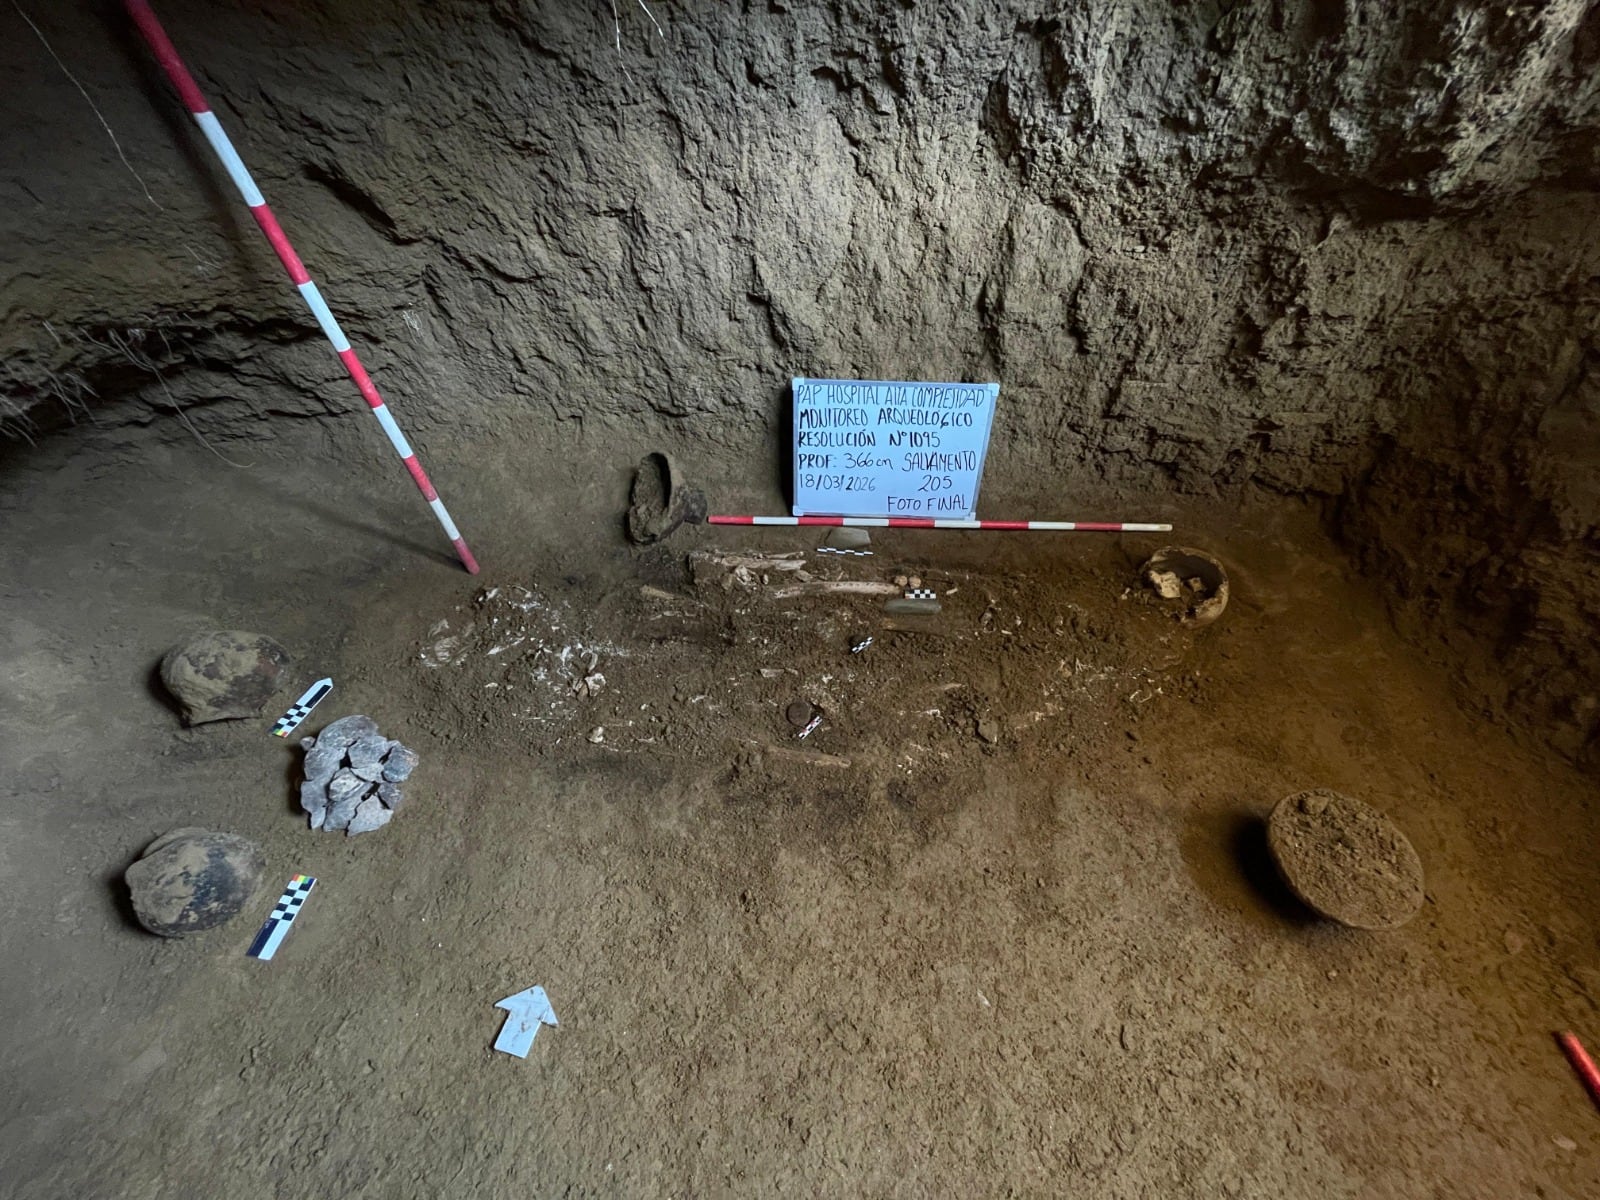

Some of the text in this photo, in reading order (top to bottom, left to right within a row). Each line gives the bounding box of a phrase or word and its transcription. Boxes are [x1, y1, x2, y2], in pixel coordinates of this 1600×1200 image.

[798, 385, 822, 404] PAP
[827, 385, 880, 405] HOSPITAL
[799, 408, 973, 429] MONITOREO ARQUEOLÓGICO
[798, 429, 876, 448] RESOLUCIÓN
[799, 454, 836, 470] PROF:
[902, 451, 976, 472] SALVAMENTO
[799, 474, 953, 492] 18/03/2026 205
[887, 495, 969, 512] FOTO FINAL
